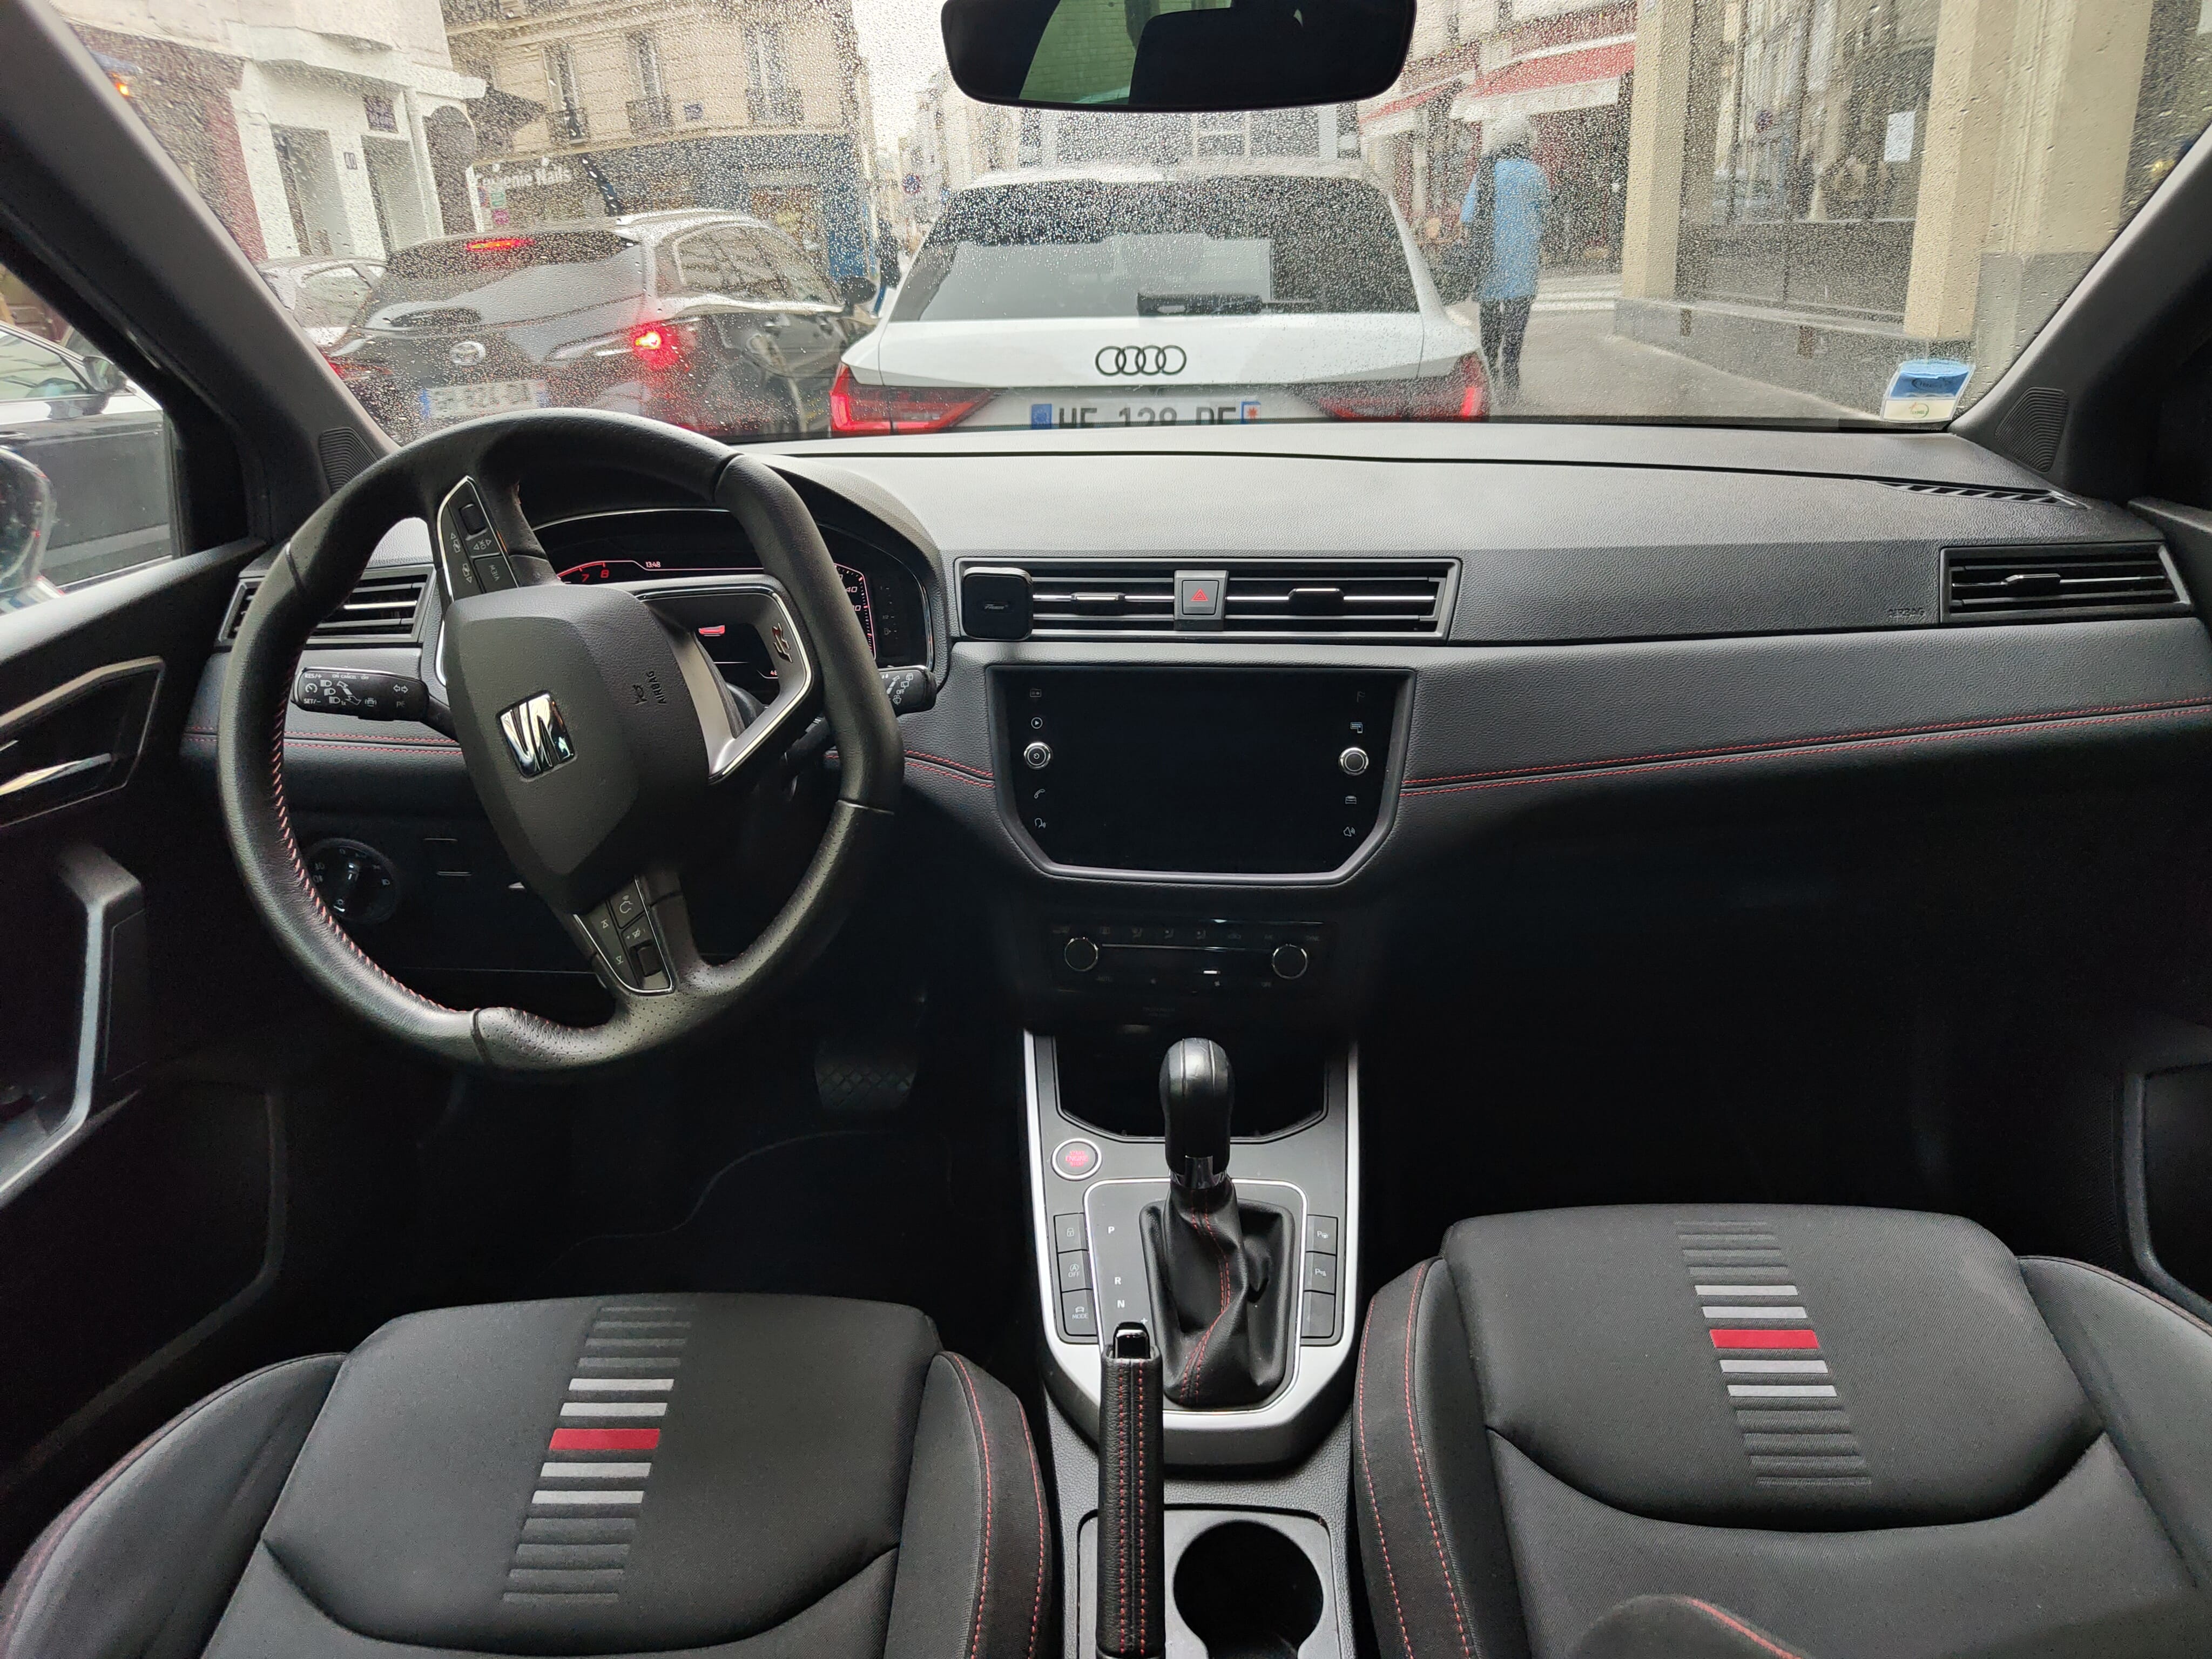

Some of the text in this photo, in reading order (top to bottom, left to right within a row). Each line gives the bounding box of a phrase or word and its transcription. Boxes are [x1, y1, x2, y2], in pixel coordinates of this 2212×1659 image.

[479, 538, 487, 550] OK
[489, 565, 500, 581] VIEW
[582, 574, 590, 582] 7
[646, 670, 667, 705] AIRBAG
[1115, 1277, 1122, 1285] R
[1117, 1300, 1125, 1309] N
